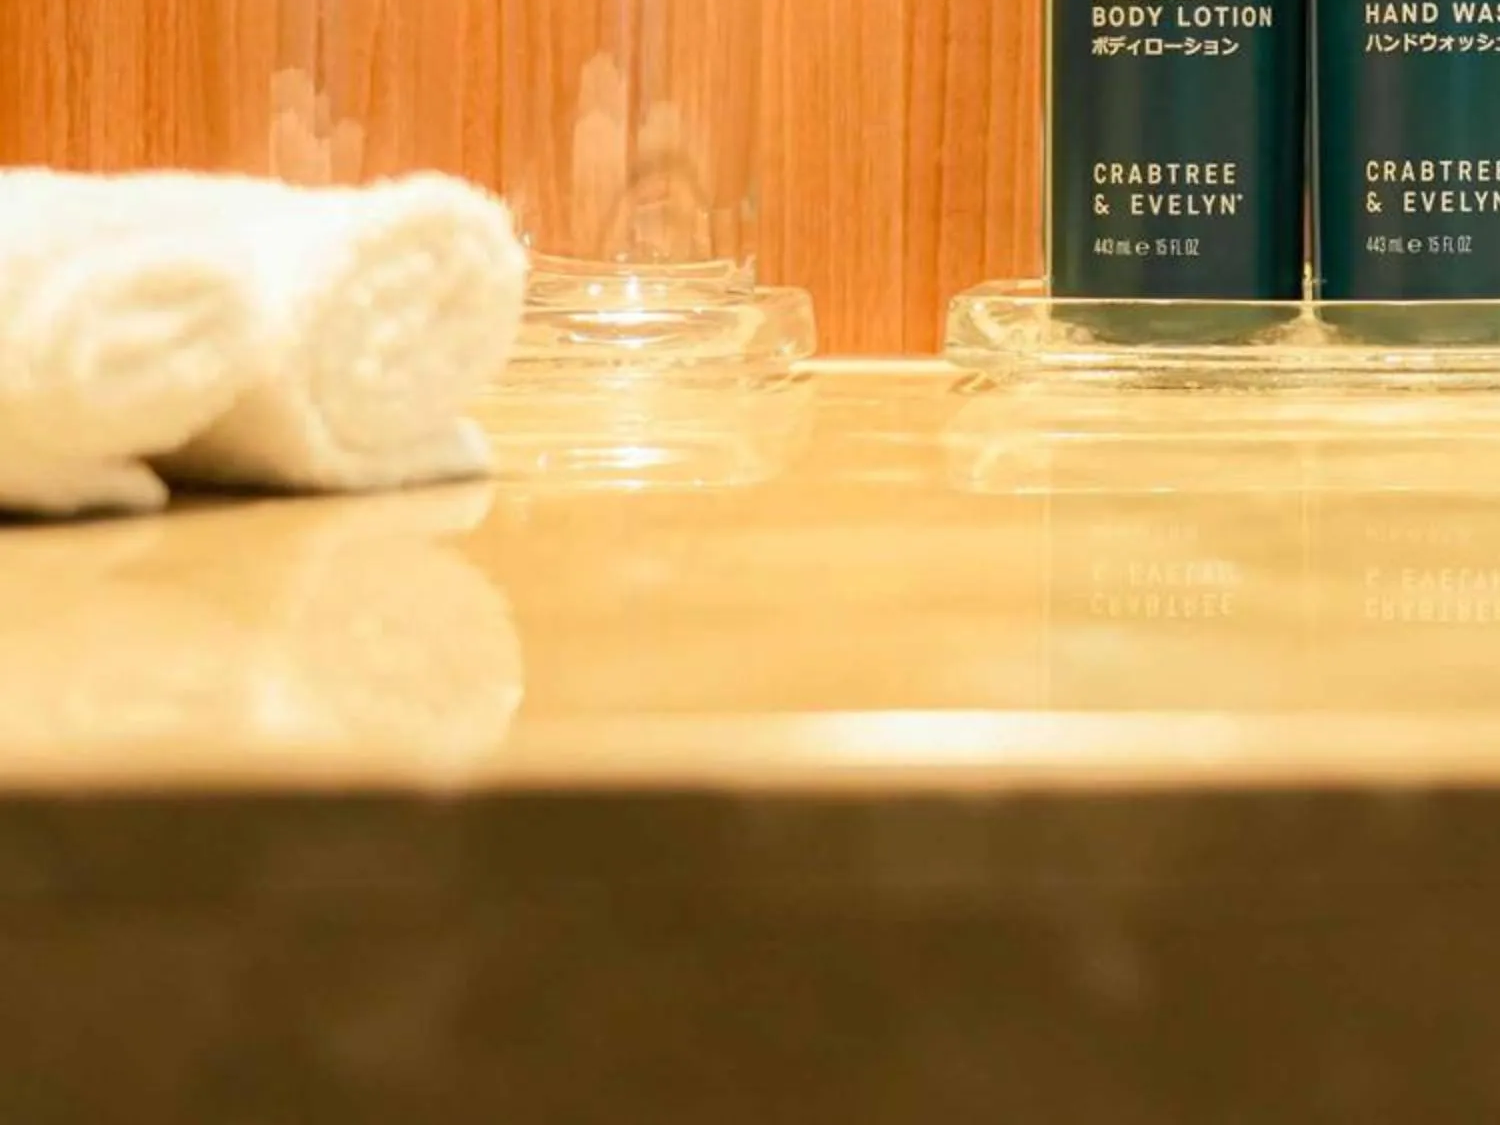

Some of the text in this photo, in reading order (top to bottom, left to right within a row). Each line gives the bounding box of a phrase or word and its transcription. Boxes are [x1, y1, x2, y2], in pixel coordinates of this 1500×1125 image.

[1092, 5, 1272, 28] BODY LOTION
[1365, 2, 1439, 24] HAND
[1093, 162, 1236, 185] CRABTREE
[1094, 193, 1110, 215] &
[1366, 190, 1382, 213] &
